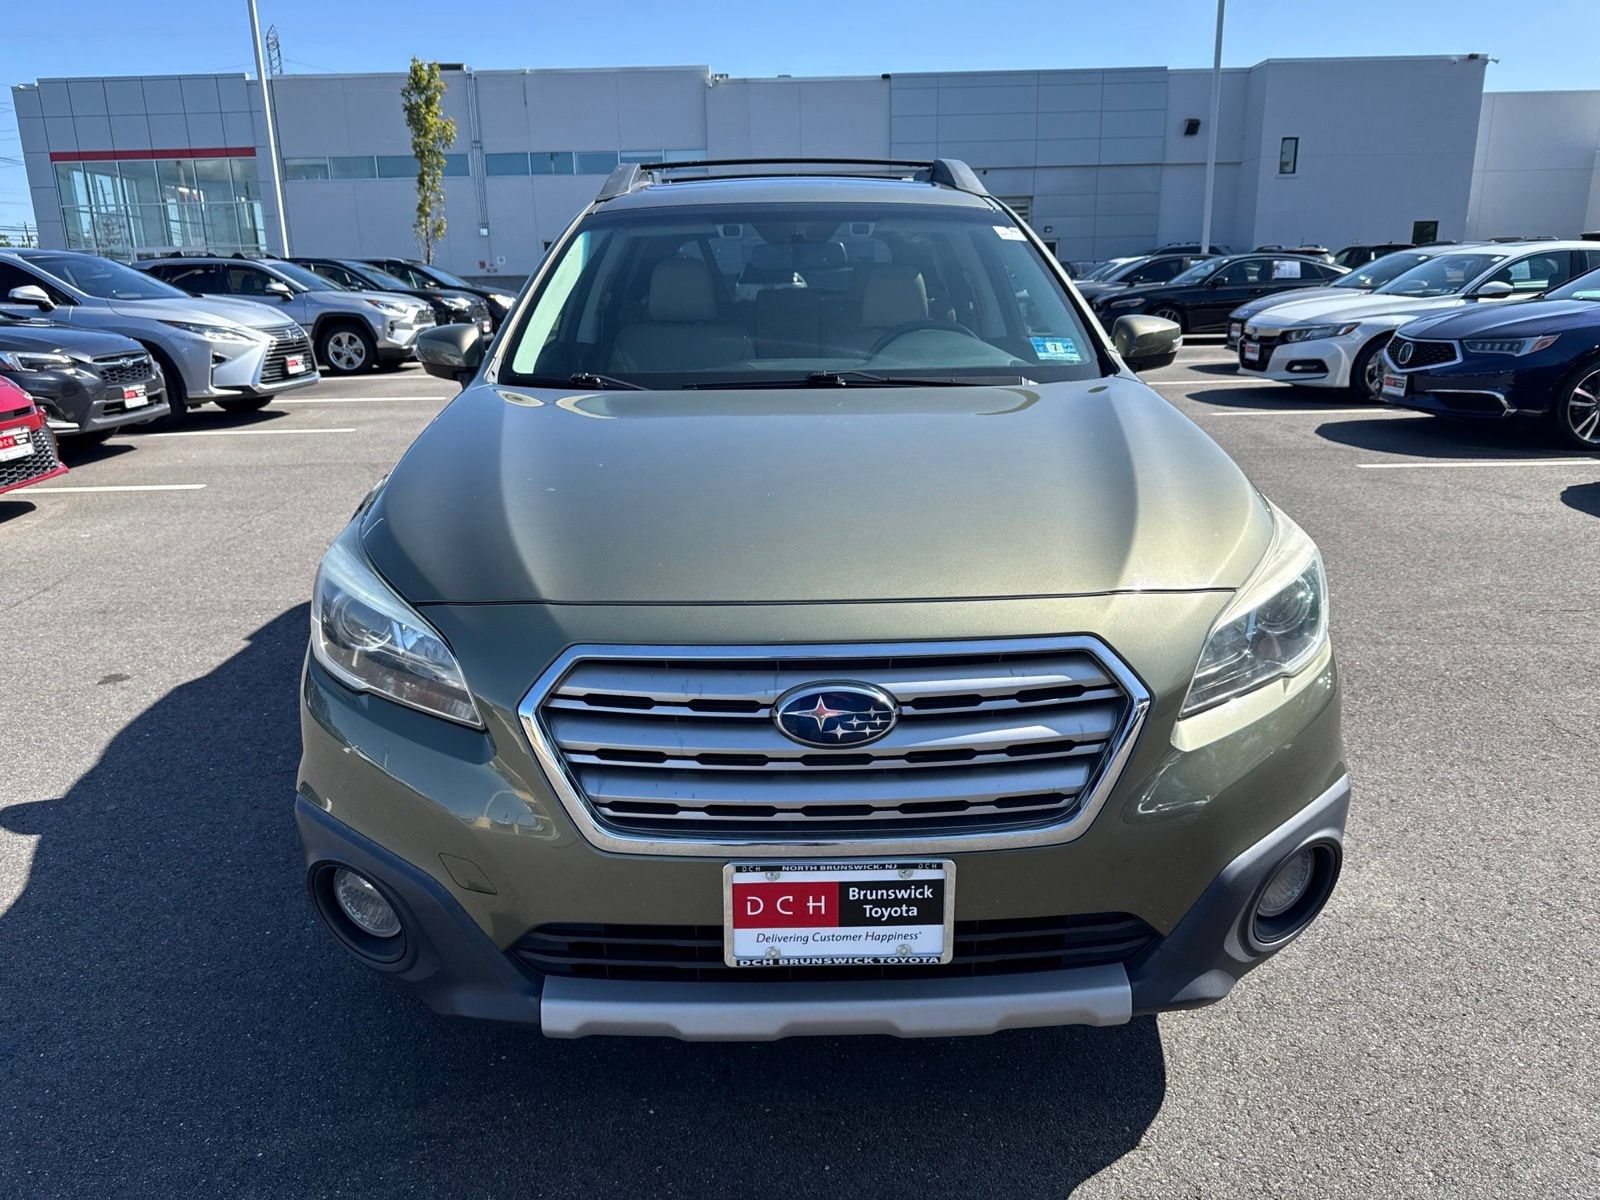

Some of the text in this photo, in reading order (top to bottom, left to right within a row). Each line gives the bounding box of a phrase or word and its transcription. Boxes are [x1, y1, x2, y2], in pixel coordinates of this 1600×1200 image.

[849, 885, 934, 900] Brunswick
[863, 904, 918, 921] Toyota
[756, 933, 809, 944] Delivering
[812, 931, 862, 942] Customer
[779, 957, 875, 965] BRUNSWICK
[880, 956, 939, 964] TOYOTA
